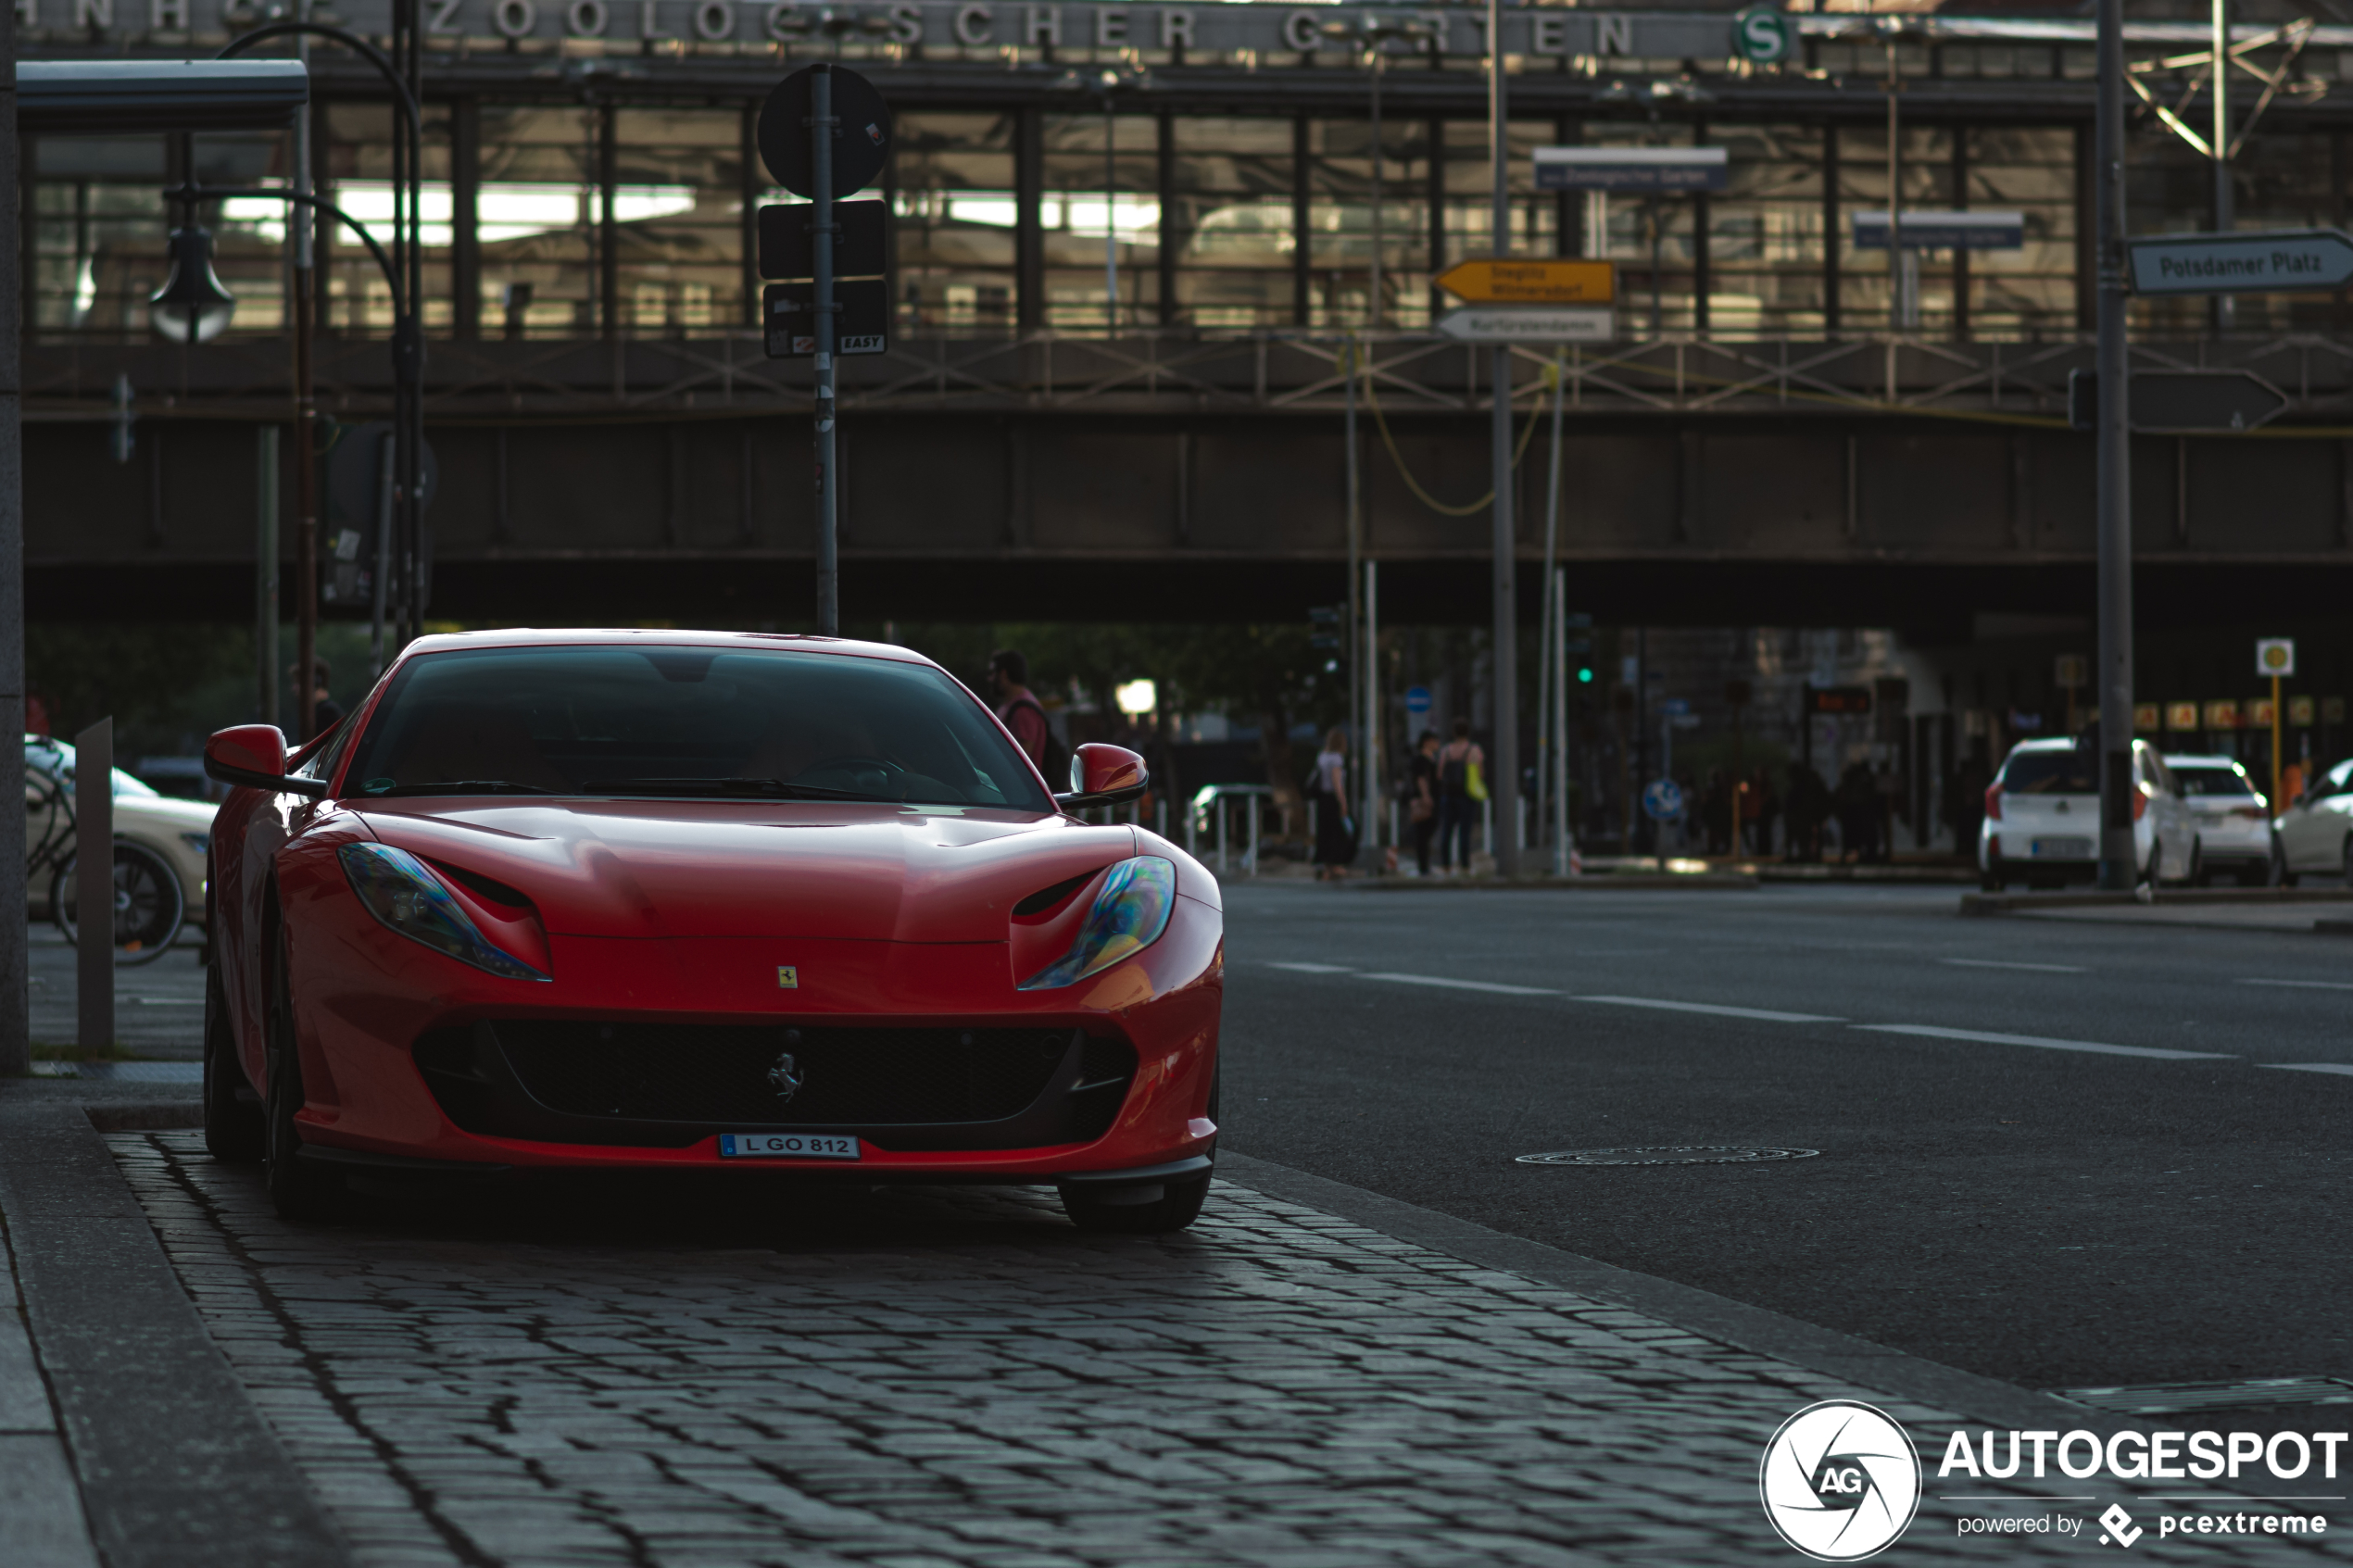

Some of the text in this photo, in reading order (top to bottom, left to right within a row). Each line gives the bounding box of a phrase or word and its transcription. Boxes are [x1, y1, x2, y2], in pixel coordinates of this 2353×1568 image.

[428, 0, 1195, 47] ZOOLOGSCHER
[1746, 13, 1782, 58] S
[2159, 251, 2322, 278] Potsdamer Platz
[845, 337, 879, 348] EASY
[746, 1138, 760, 1151] L
[767, 1137, 802, 1151] GO
[810, 1138, 849, 1153] 812
